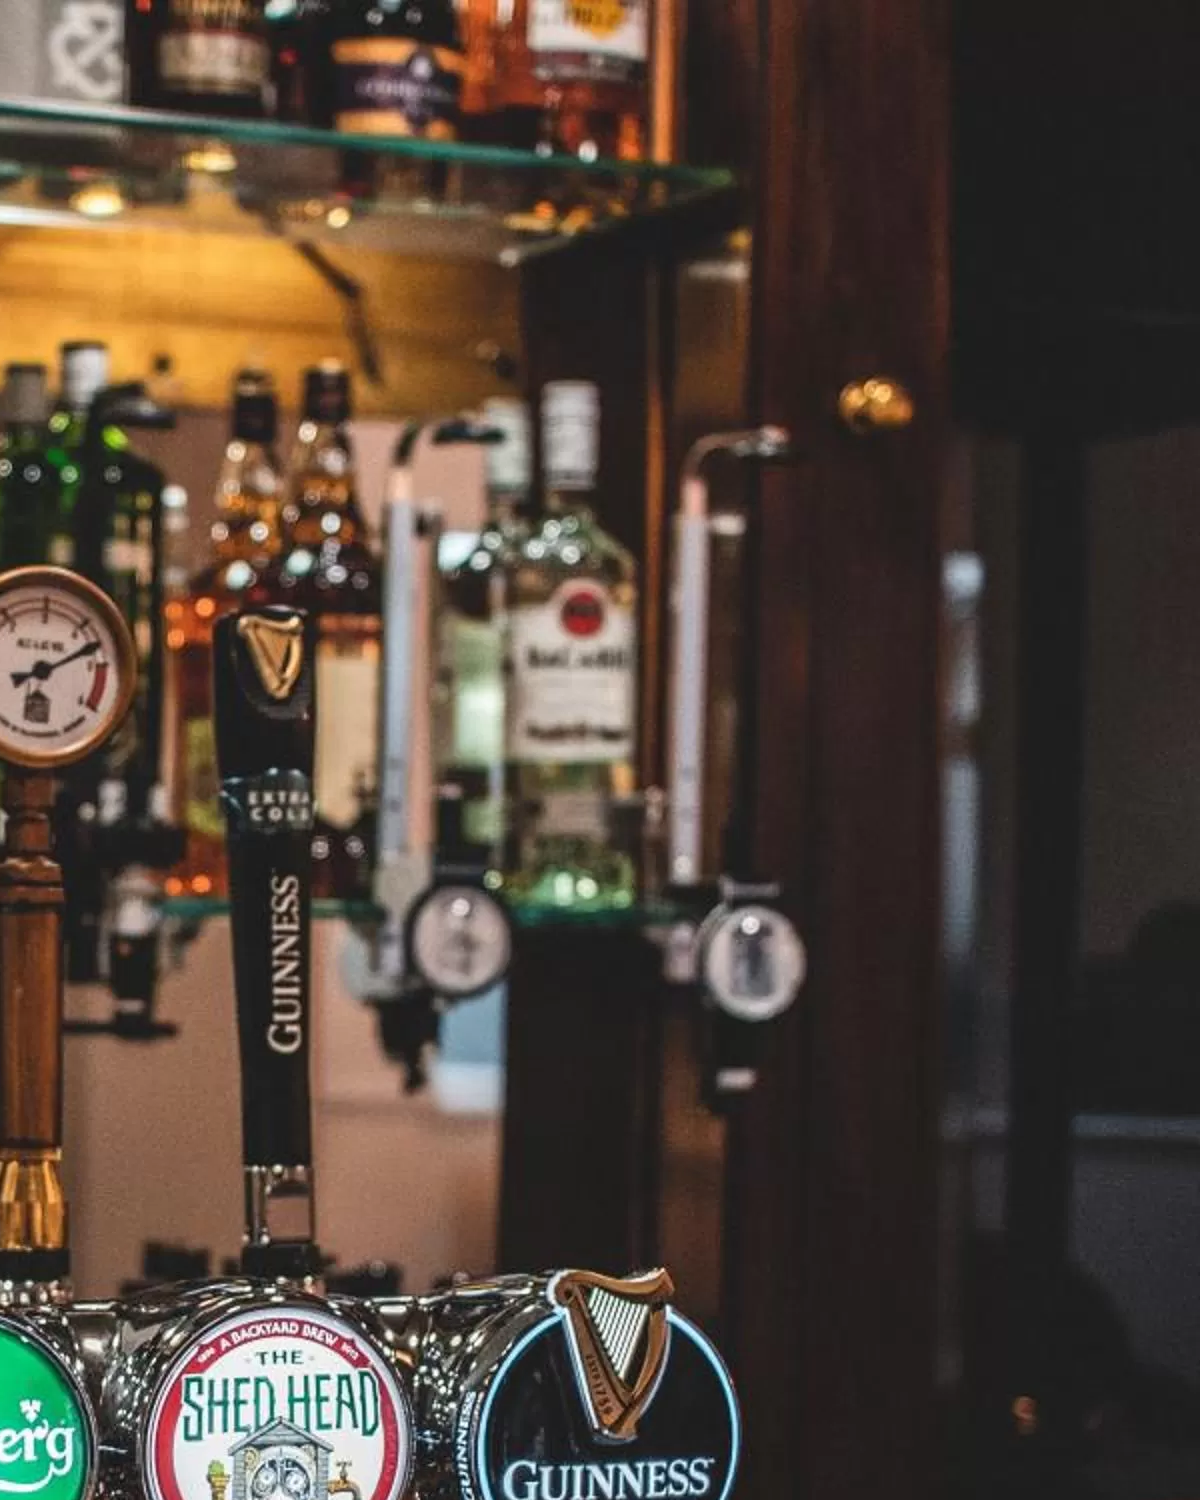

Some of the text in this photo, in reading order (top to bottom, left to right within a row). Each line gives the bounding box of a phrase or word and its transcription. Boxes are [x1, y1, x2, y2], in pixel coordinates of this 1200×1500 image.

[267, 874, 302, 1053] GUINNESS
[230, 1321, 299, 1345] BACKYARD
[301, 1323, 338, 1347] BREW
[255, 1350, 305, 1366] THE
[182, 1370, 380, 1442] SHED HEAD
